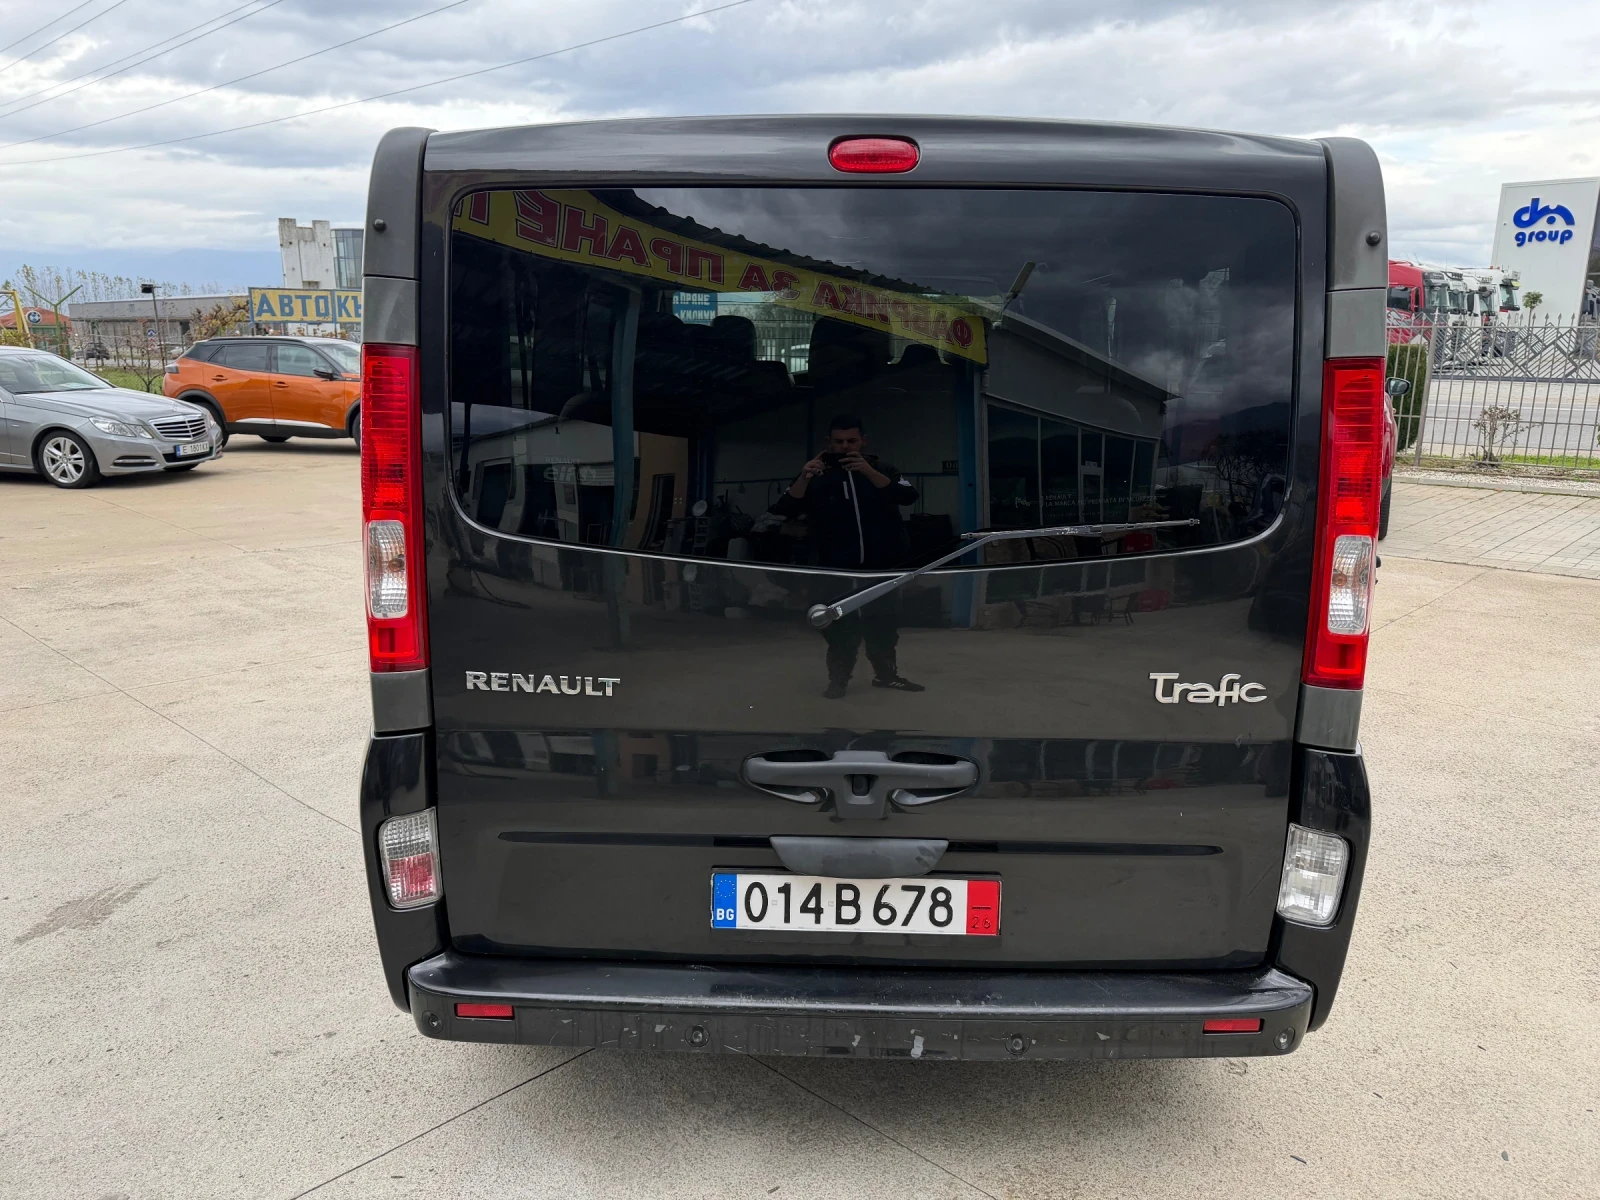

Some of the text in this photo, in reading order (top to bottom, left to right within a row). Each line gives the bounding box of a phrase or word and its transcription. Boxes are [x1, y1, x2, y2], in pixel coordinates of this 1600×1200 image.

[1515, 228, 1573, 247] group
[465, 670, 621, 697] RENAULT
[1149, 672, 1268, 706] Trafic
[716, 908, 735, 921] BG
